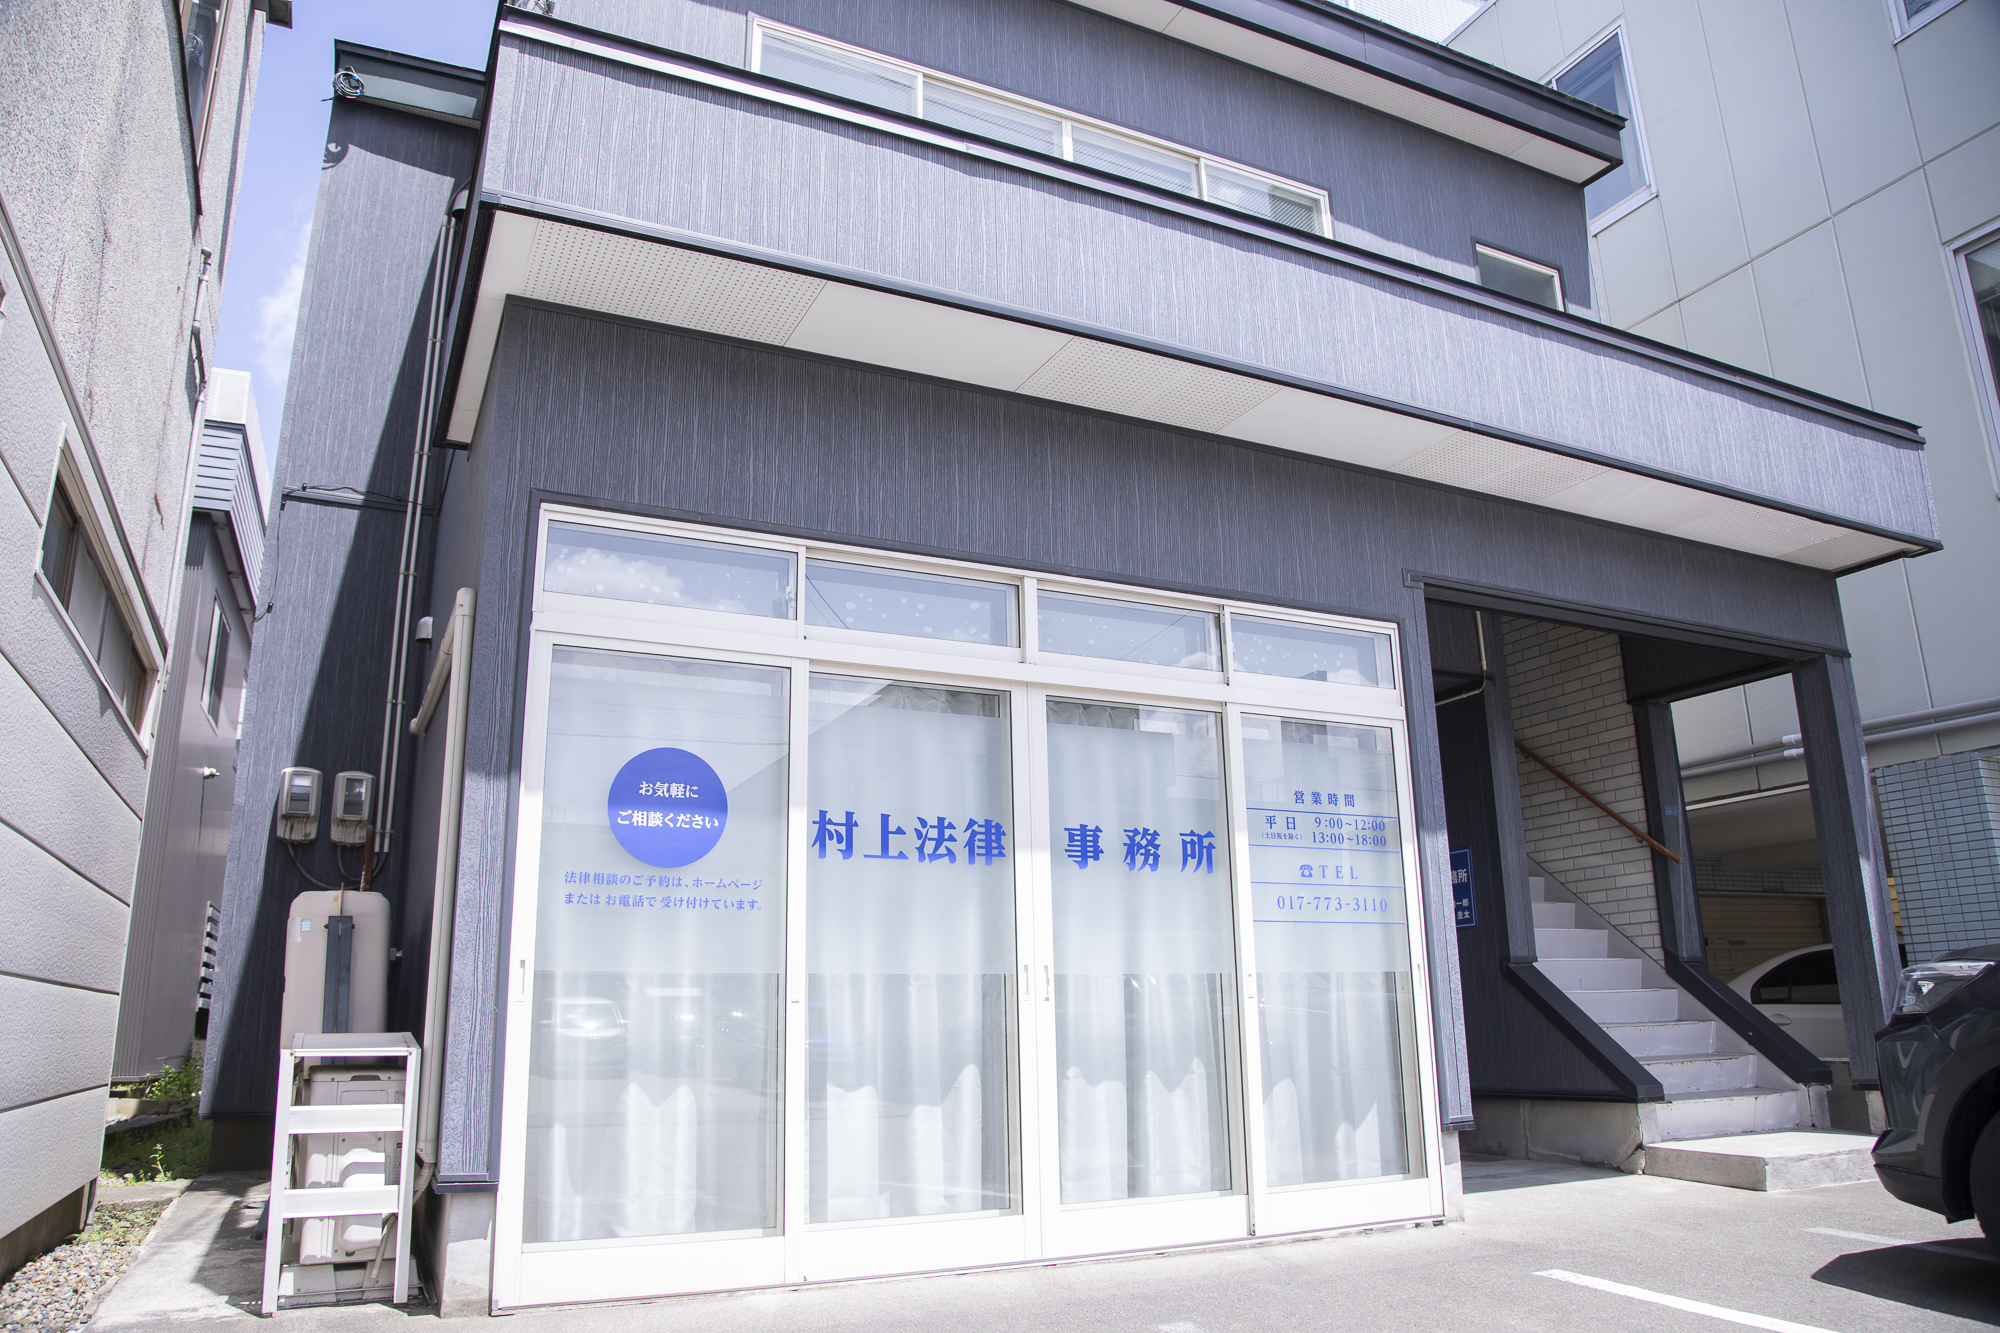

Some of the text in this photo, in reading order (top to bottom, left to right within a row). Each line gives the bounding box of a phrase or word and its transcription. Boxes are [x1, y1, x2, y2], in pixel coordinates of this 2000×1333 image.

[639, 781, 699, 798] お気軽に
[1293, 790, 1356, 808] 営業時間
[616, 810, 719, 829] ご相談ください
[1264, 815, 1297, 831] 平日
[564, 871, 763, 891] 法律相談のご予約は、ホームページ
[1277, 895, 1388, 912] 017-773-3110
